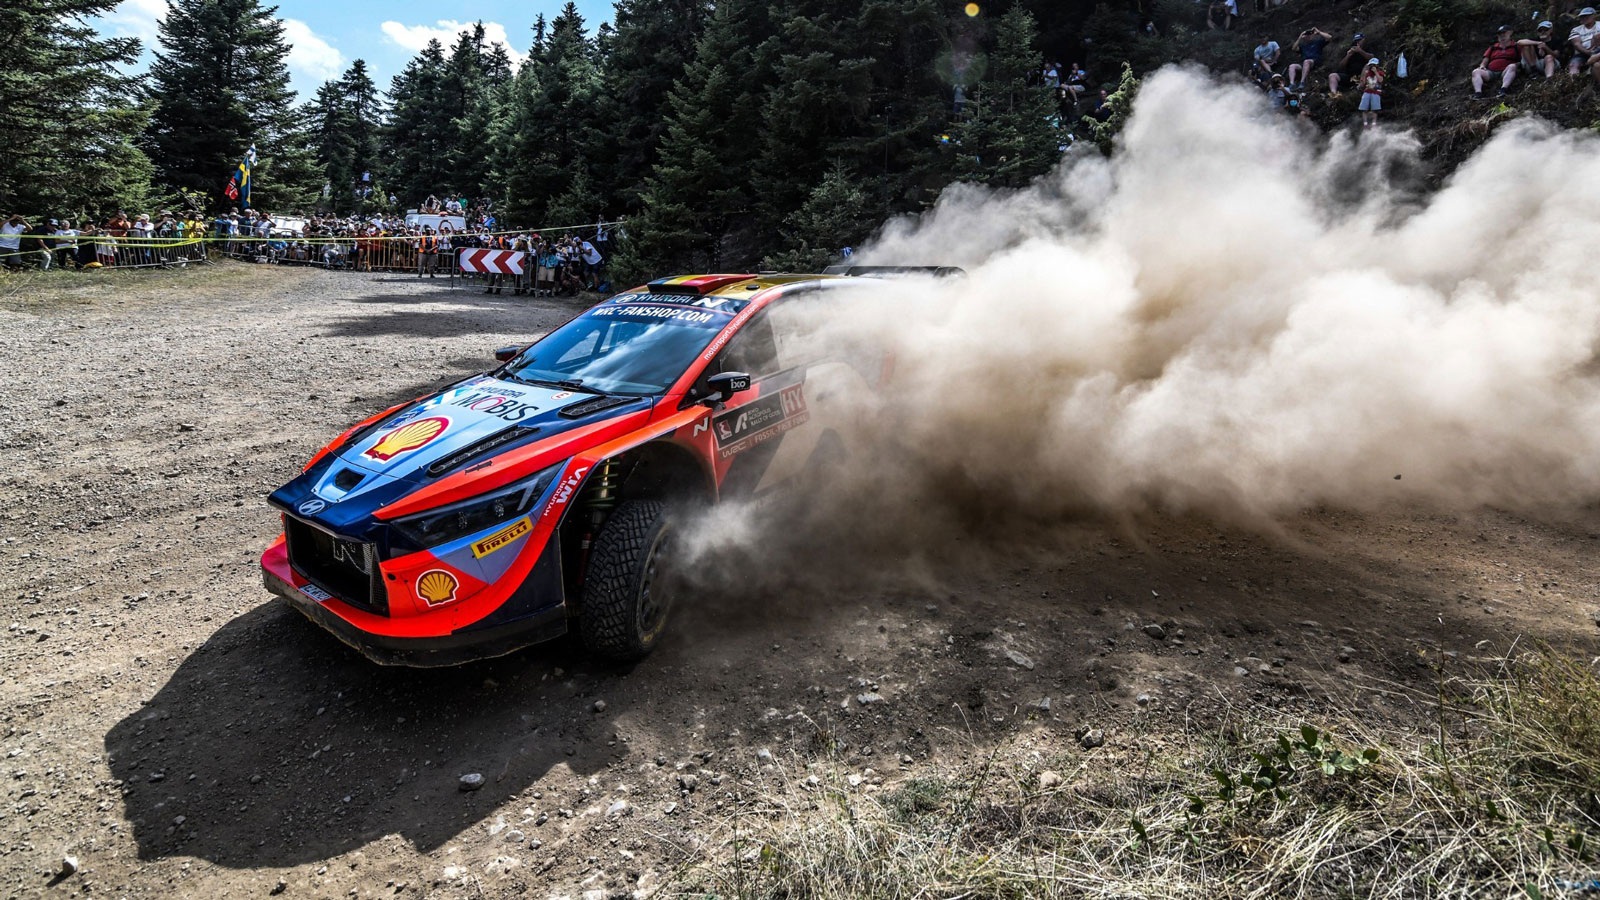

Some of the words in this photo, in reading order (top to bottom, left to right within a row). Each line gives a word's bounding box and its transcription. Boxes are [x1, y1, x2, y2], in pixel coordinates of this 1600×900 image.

[592, 305, 715, 323] WRC-FANSHOP.COM
[636, 294, 694, 304] HYUNDAI
[690, 297, 730, 308] N
[704, 303, 759, 361] motorsport.hyundai.com
[476, 386, 527, 398] HYUNDAI
[730, 378, 746, 389] ixo
[451, 393, 540, 421] MOBIS
[782, 387, 803, 414] HY
[543, 480, 567, 517] HYUNDAI
[476, 521, 528, 554] PIRELLI
